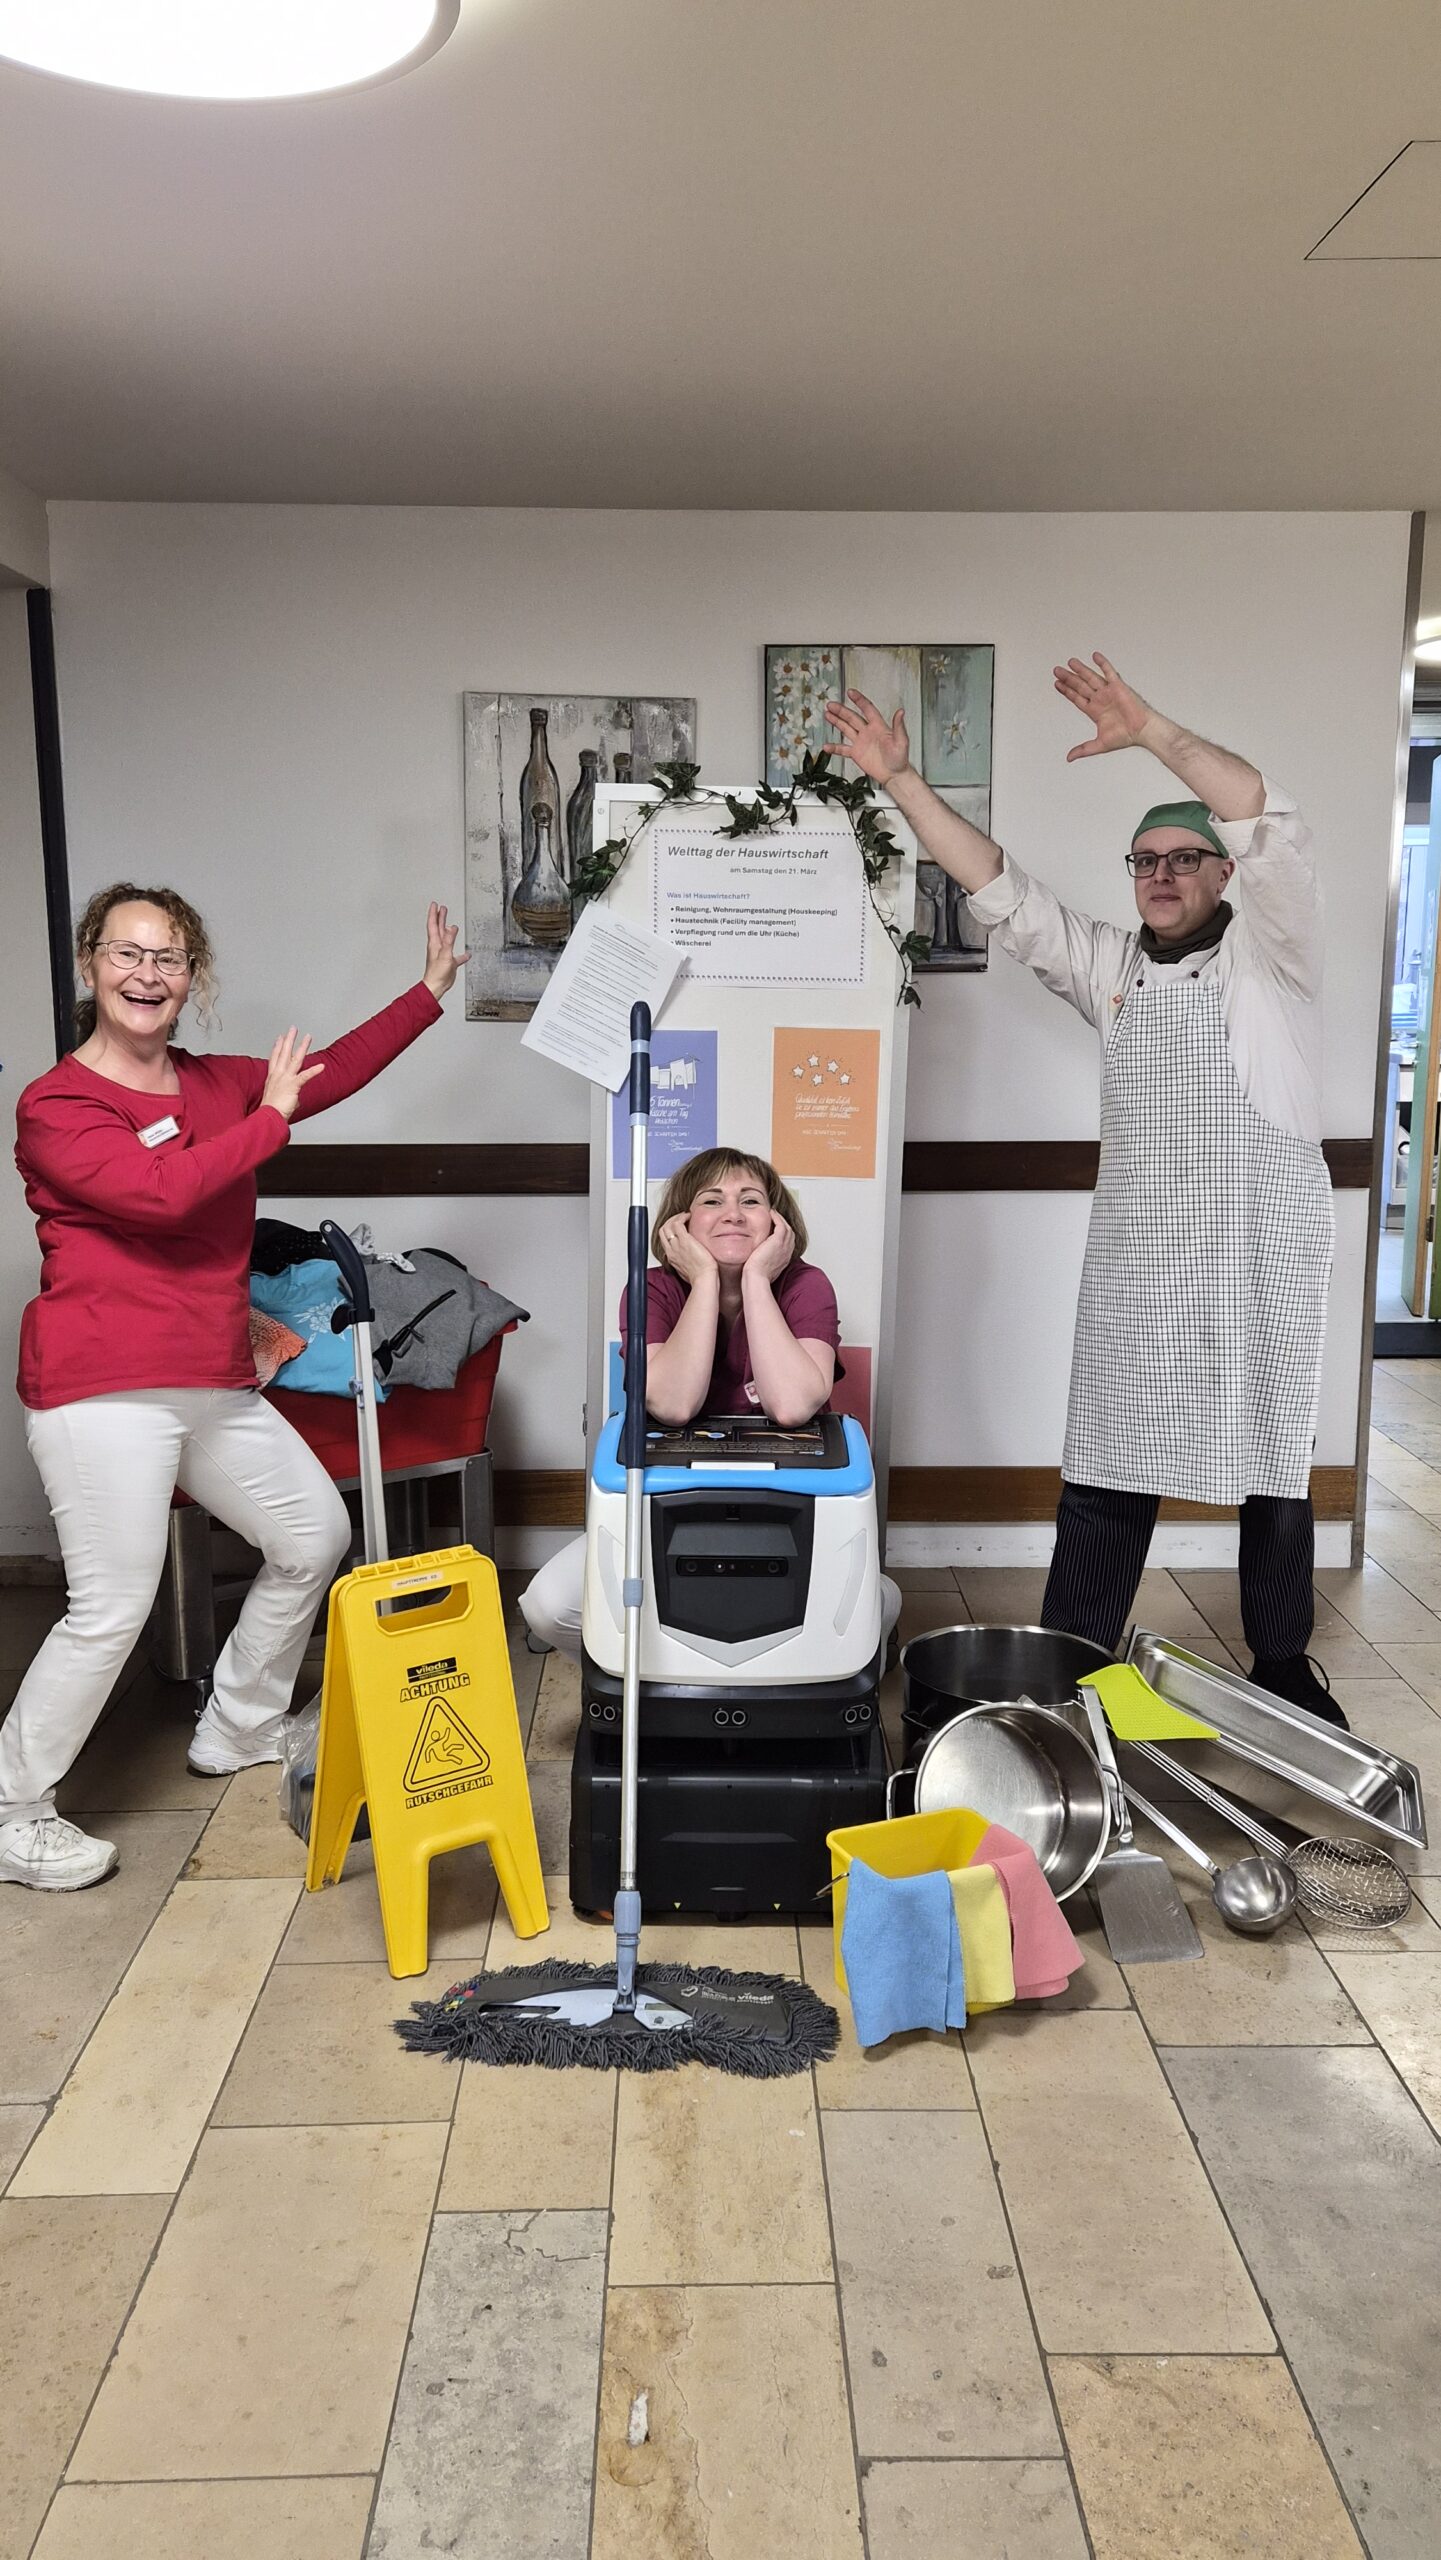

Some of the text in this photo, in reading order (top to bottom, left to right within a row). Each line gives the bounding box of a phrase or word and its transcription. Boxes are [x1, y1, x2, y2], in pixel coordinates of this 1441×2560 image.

[668, 846, 829, 859] Welttag der Hauswirtschaft
[742, 866, 773, 875] Samstag
[693, 892, 750, 900] Hauswirtschaft?
[675, 906, 838, 916] Reinigung, Wohnraumgestaltung (Houskeeping)
[720, 918, 748, 926] (Facility
[675, 928, 716, 936] Verpflegung
[773, 930, 800, 938] (Küche)
[416, 1661, 448, 1674] vileda
[400, 1672, 470, 1702] ACHTUNG
[406, 1774, 494, 1809] RUTSCHGEFAHR
[738, 1992, 774, 2002] vileda
